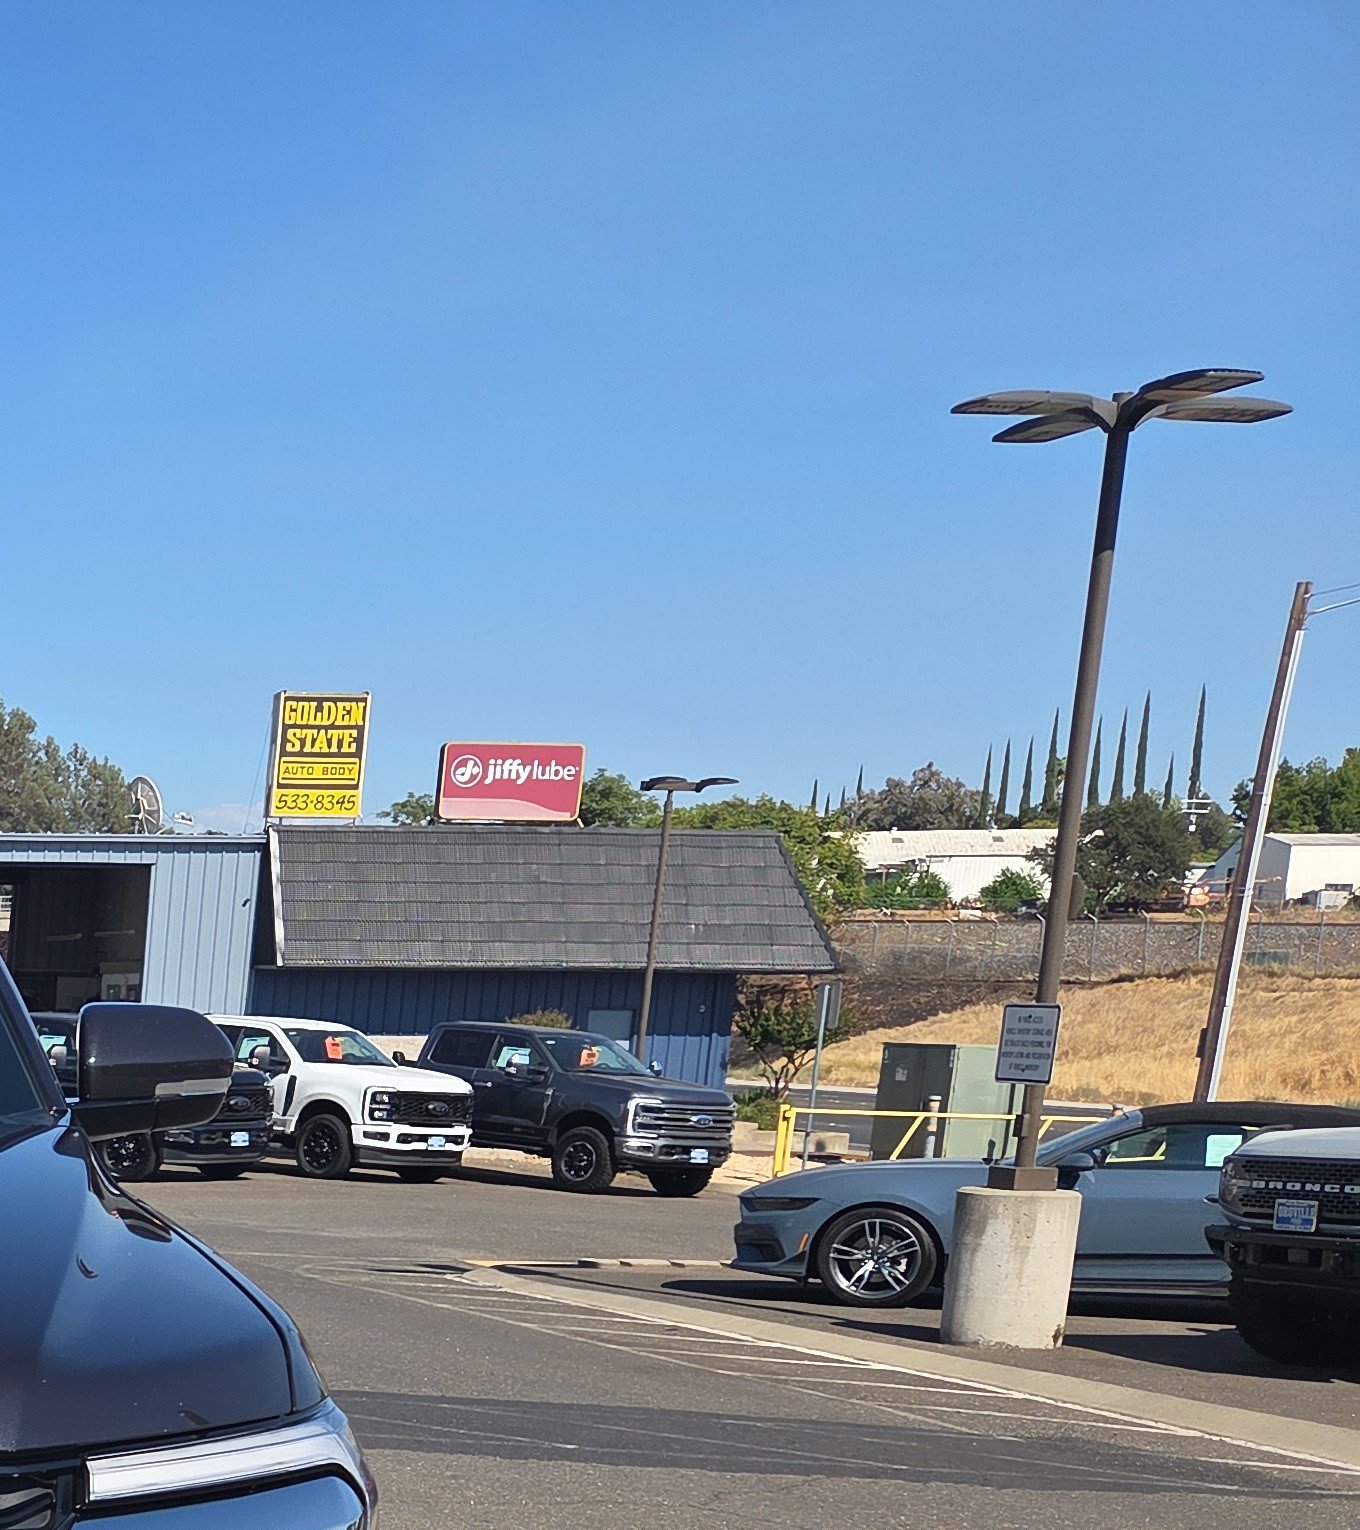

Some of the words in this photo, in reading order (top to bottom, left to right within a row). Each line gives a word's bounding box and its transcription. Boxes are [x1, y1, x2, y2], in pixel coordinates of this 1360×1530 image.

[284, 701, 366, 726] GOLDEN
[285, 729, 358, 753] STATE
[283, 766, 315, 776] AUTO
[321, 766, 355, 776] BODY
